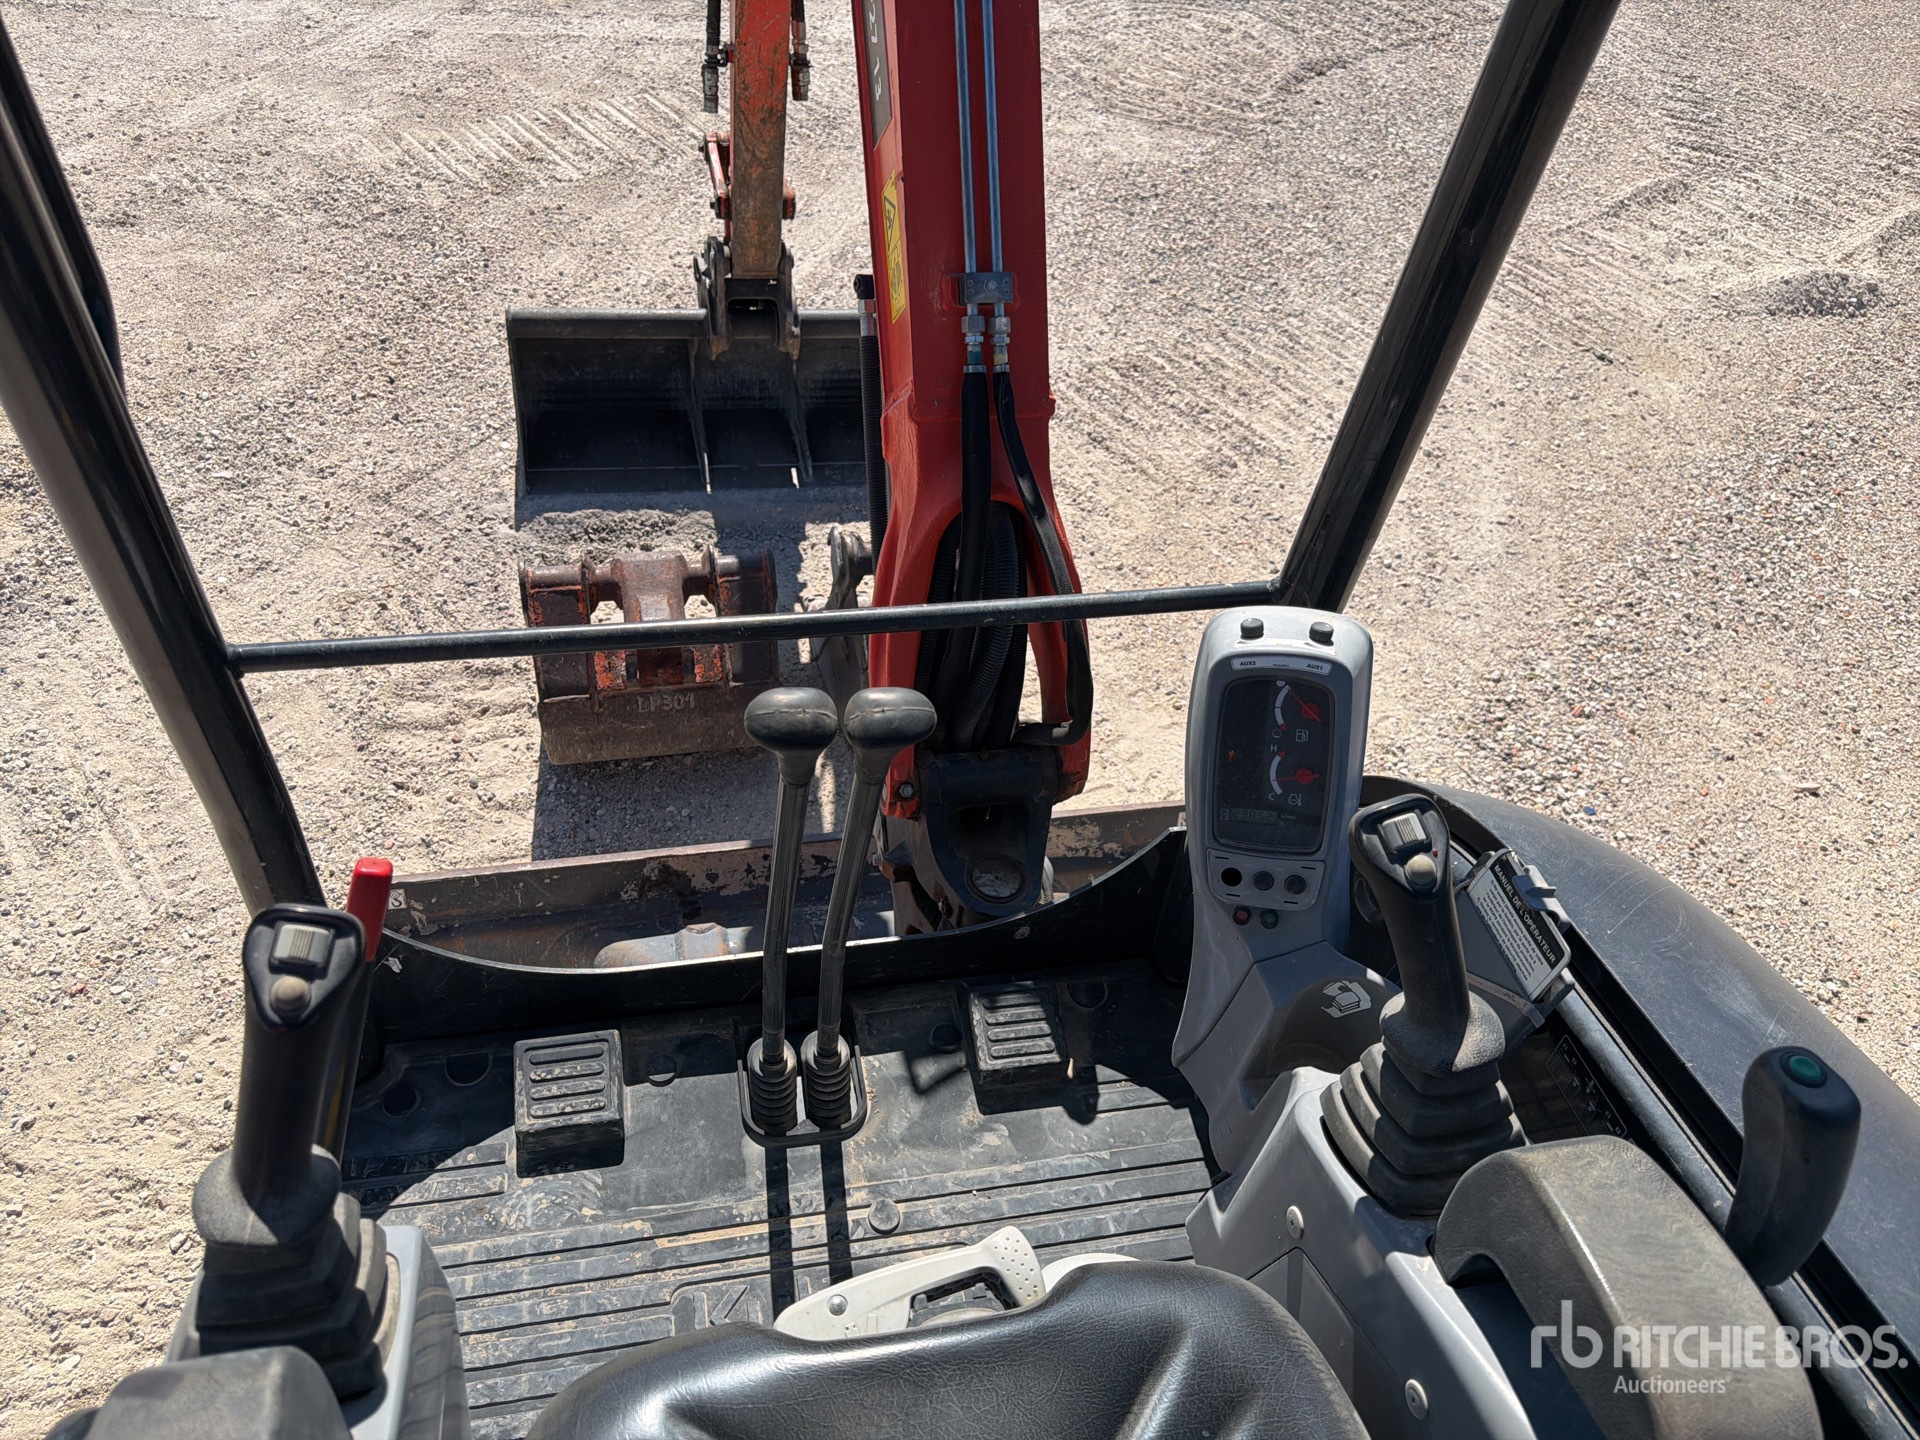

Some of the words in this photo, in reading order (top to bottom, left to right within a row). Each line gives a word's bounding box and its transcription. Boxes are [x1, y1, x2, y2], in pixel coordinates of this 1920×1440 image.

[1239, 660, 1257, 668] AUX2
[1306, 663, 1323, 671] AUX1
[1270, 744, 1278, 752] H
[1268, 792, 1276, 801] C
[1492, 863, 1516, 897] MANUEL
[1511, 895, 1523, 909] DE
[1519, 908, 1557, 964] L'OPÉRATEUR
